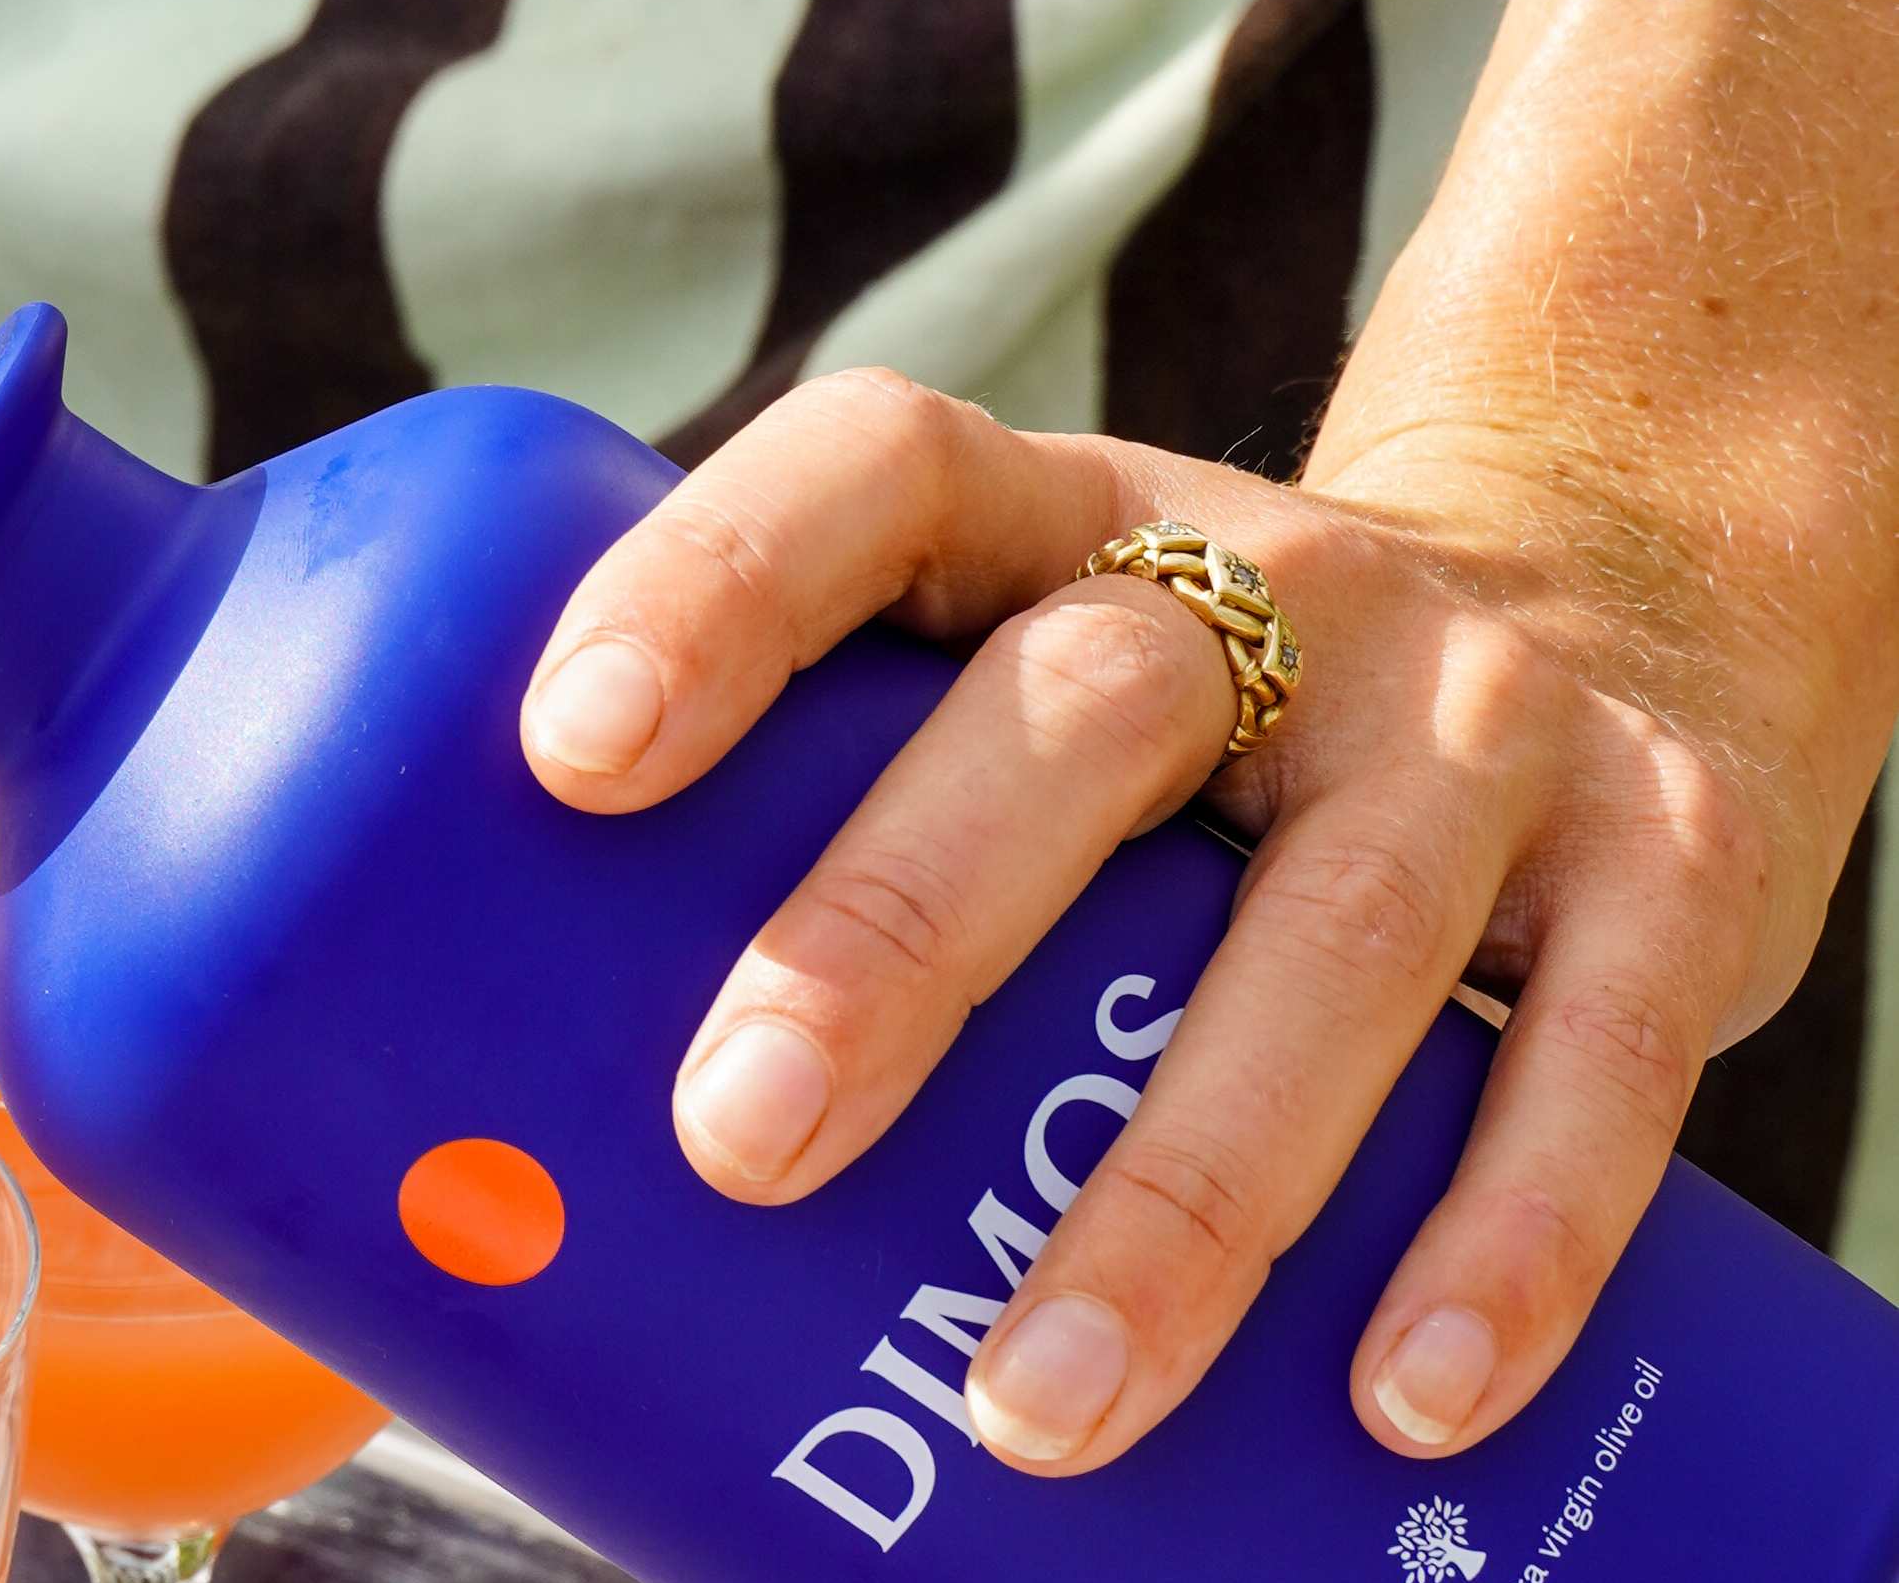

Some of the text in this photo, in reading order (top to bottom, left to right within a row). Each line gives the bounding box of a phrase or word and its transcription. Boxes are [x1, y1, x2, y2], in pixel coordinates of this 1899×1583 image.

[770, 974, 1185, 1553] DIMOS
[1538, 1475, 1603, 1558] virgin
[1594, 1402, 1643, 1472] olive
[1634, 1356, 1664, 1401] oil
